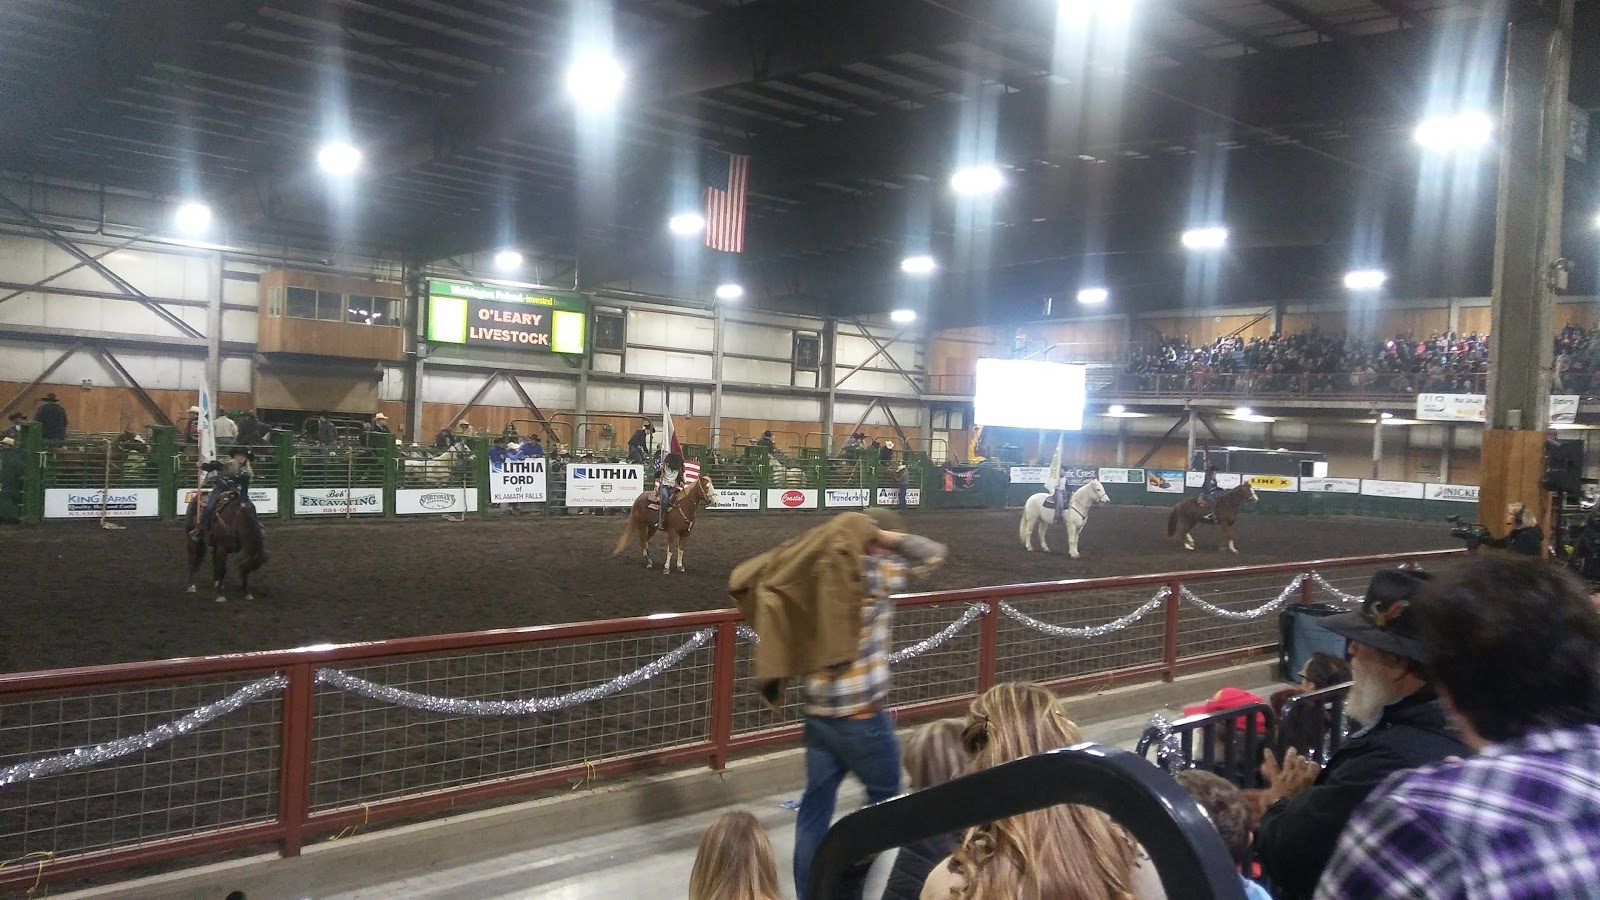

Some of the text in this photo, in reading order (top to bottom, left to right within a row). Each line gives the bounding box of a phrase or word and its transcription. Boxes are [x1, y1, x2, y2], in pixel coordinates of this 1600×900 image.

[526, 294, 553, 306] invested
[478, 308, 542, 326] O'LEARY
[470, 326, 549, 346] LIVESTOCK
[504, 462, 544, 473] LITHIA
[588, 468, 638, 480] LITHIA
[1076, 468, 1096, 479] Crest
[503, 475, 534, 485] FORD
[68, 493, 99, 503] KING
[301, 496, 377, 507] EXCAVATING
[525, 492, 543, 500] FALLS
[782, 494, 803, 503] Coastal
